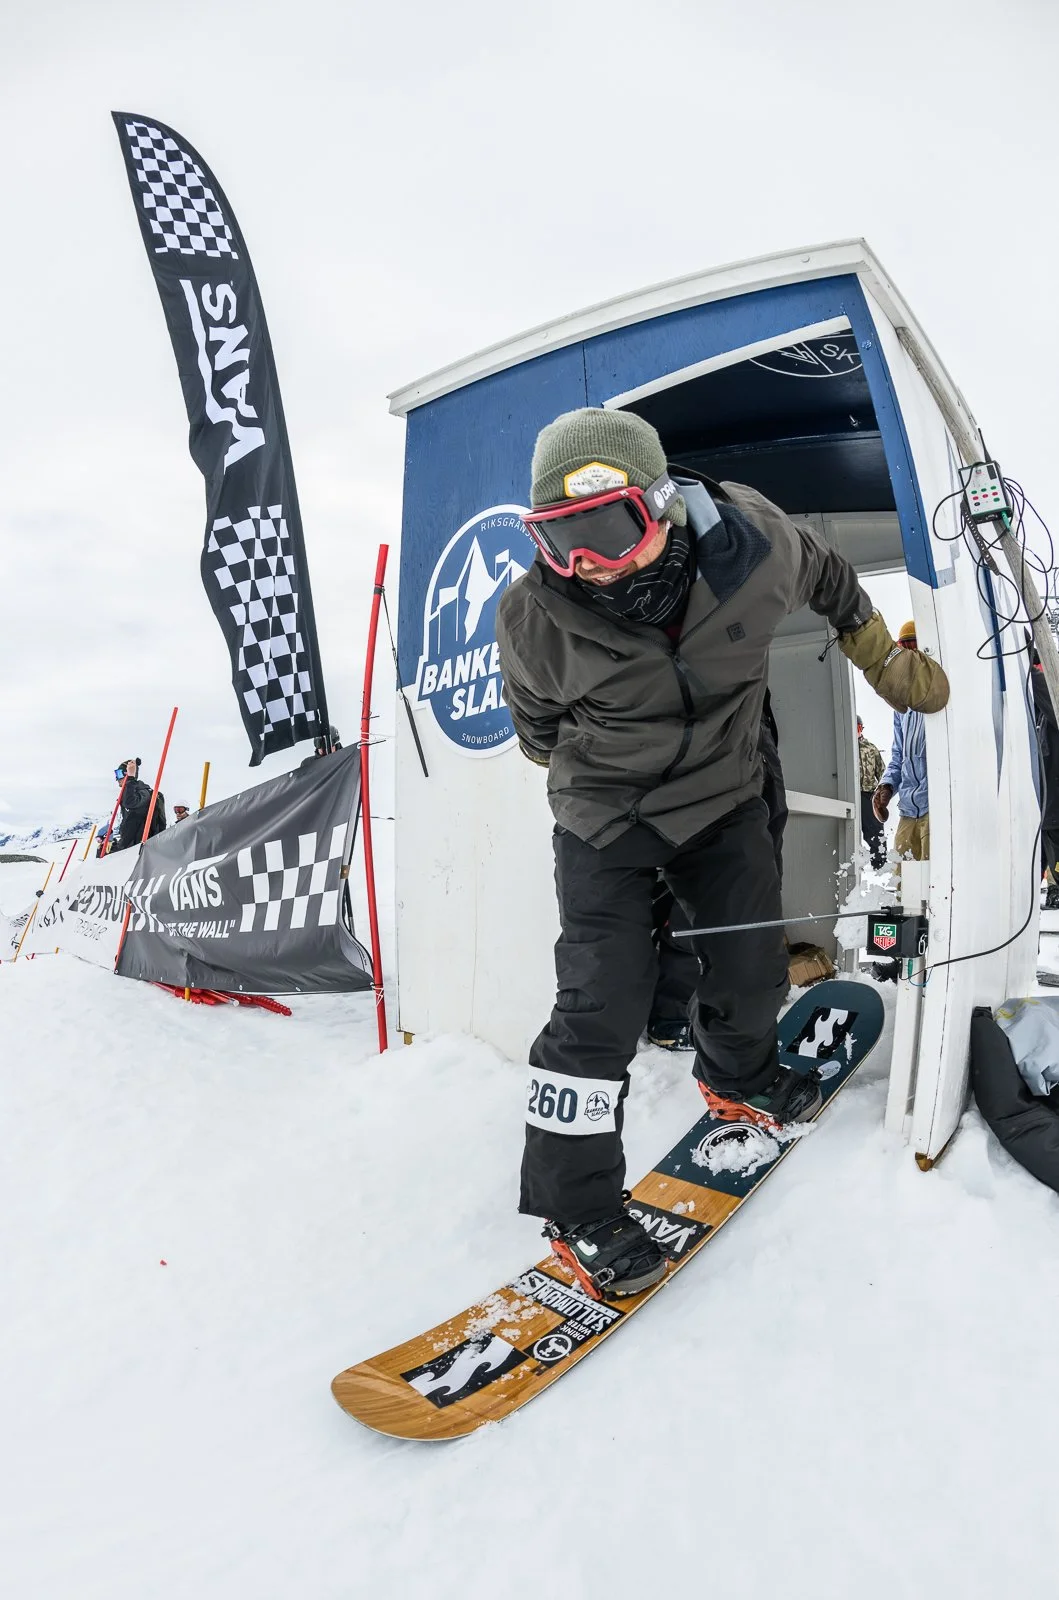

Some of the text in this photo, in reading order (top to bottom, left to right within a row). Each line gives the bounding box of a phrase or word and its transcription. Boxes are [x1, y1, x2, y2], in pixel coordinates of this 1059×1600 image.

[179, 279, 266, 476] VANS
[660, 480, 677, 501] DRA
[421, 641, 501, 696] BANKE
[461, 726, 510, 745] SNOWBOARD
[168, 852, 229, 912] VANS
[197, 919, 236, 938] WALL"
[877, 926, 893, 936] TAG
[527, 1078, 578, 1123] 260
[560, 1324, 586, 1341] DRINK
[566, 1319, 592, 1336] WATER
